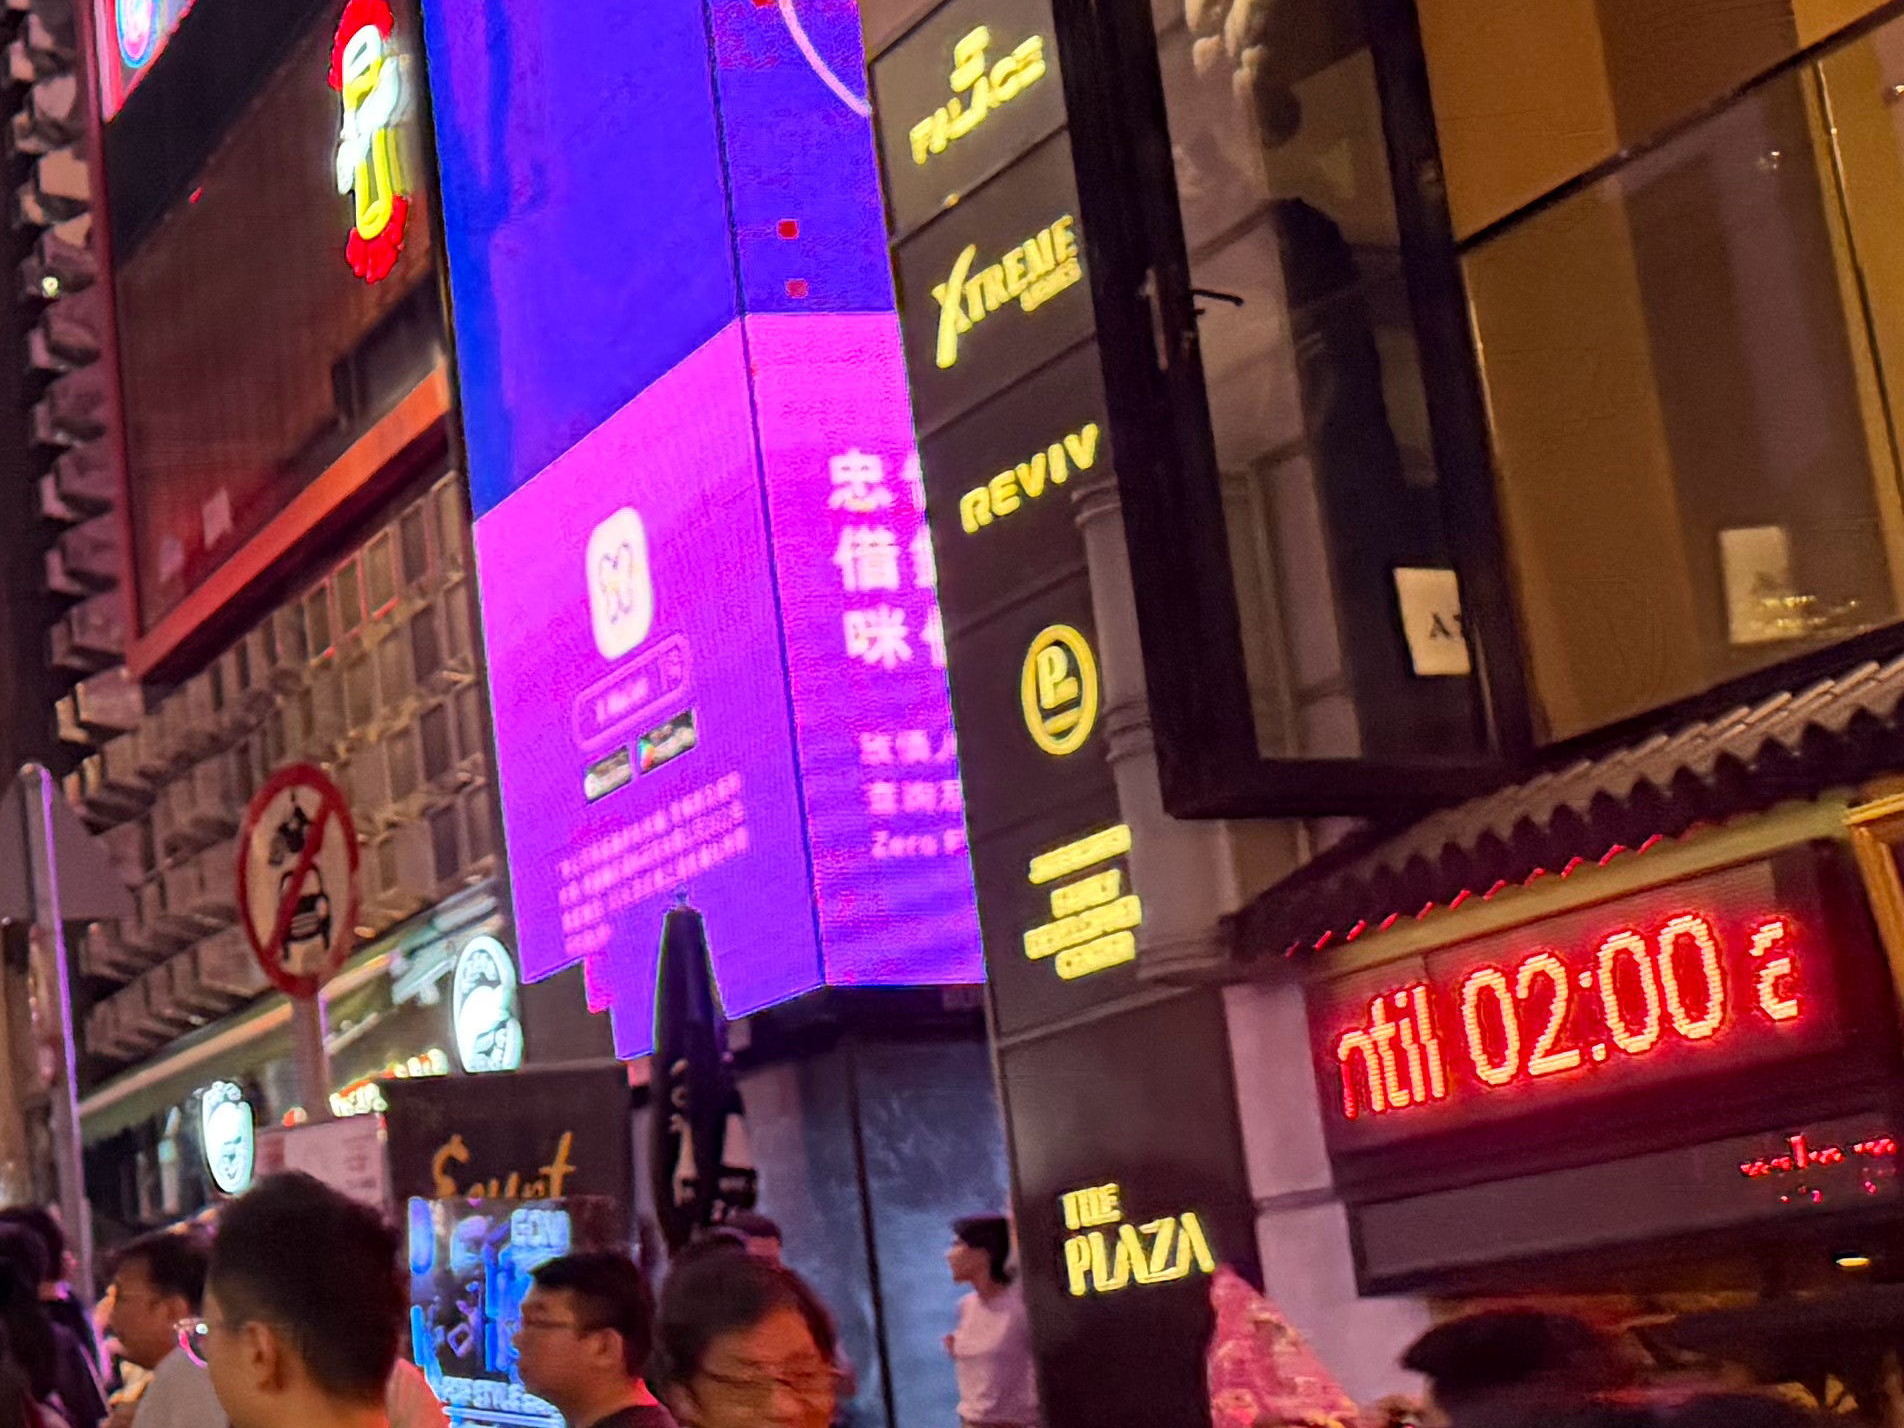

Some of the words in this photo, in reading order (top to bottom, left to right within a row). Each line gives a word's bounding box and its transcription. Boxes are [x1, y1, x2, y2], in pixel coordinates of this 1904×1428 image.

[931, 214, 1080, 369] XTREME
[960, 422, 1099, 535] REVIV
[1461, 913, 1726, 1087] 02:00
[1061, 1182, 1123, 1231] THE
[1064, 1211, 1217, 1297] PLAZA
